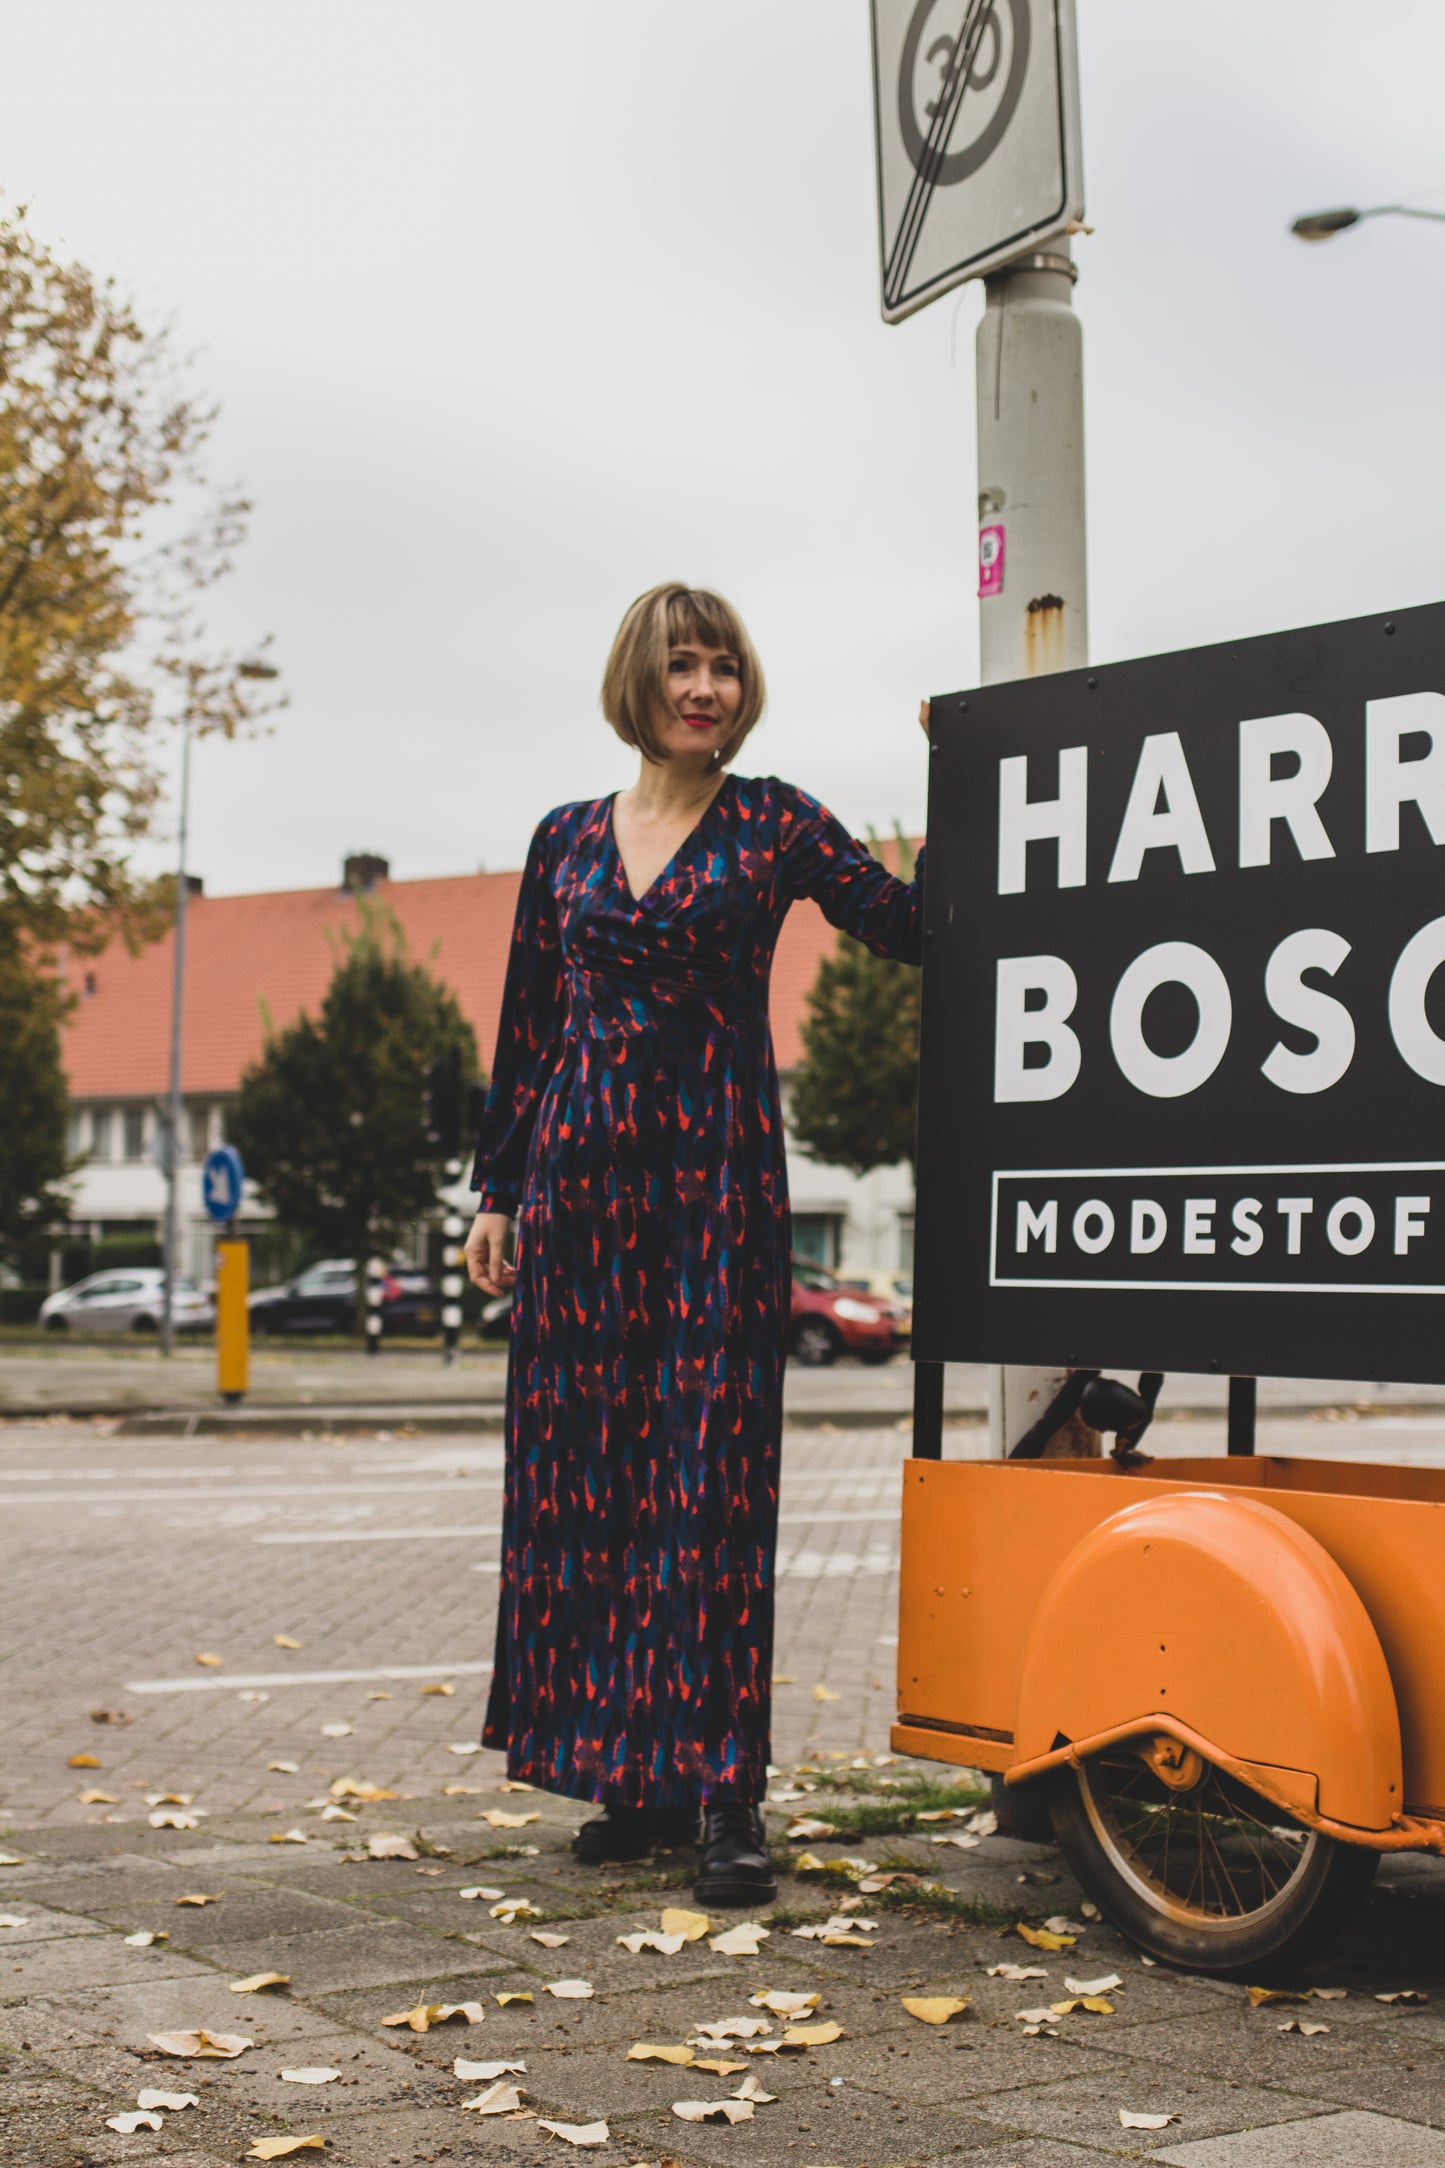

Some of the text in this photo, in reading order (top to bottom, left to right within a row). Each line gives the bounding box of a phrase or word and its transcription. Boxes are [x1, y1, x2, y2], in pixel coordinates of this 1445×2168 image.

[922, 6, 1004, 120] 30
[998, 691, 1445, 895] HARR
[1016, 1196, 1431, 1256] MODESTOF
